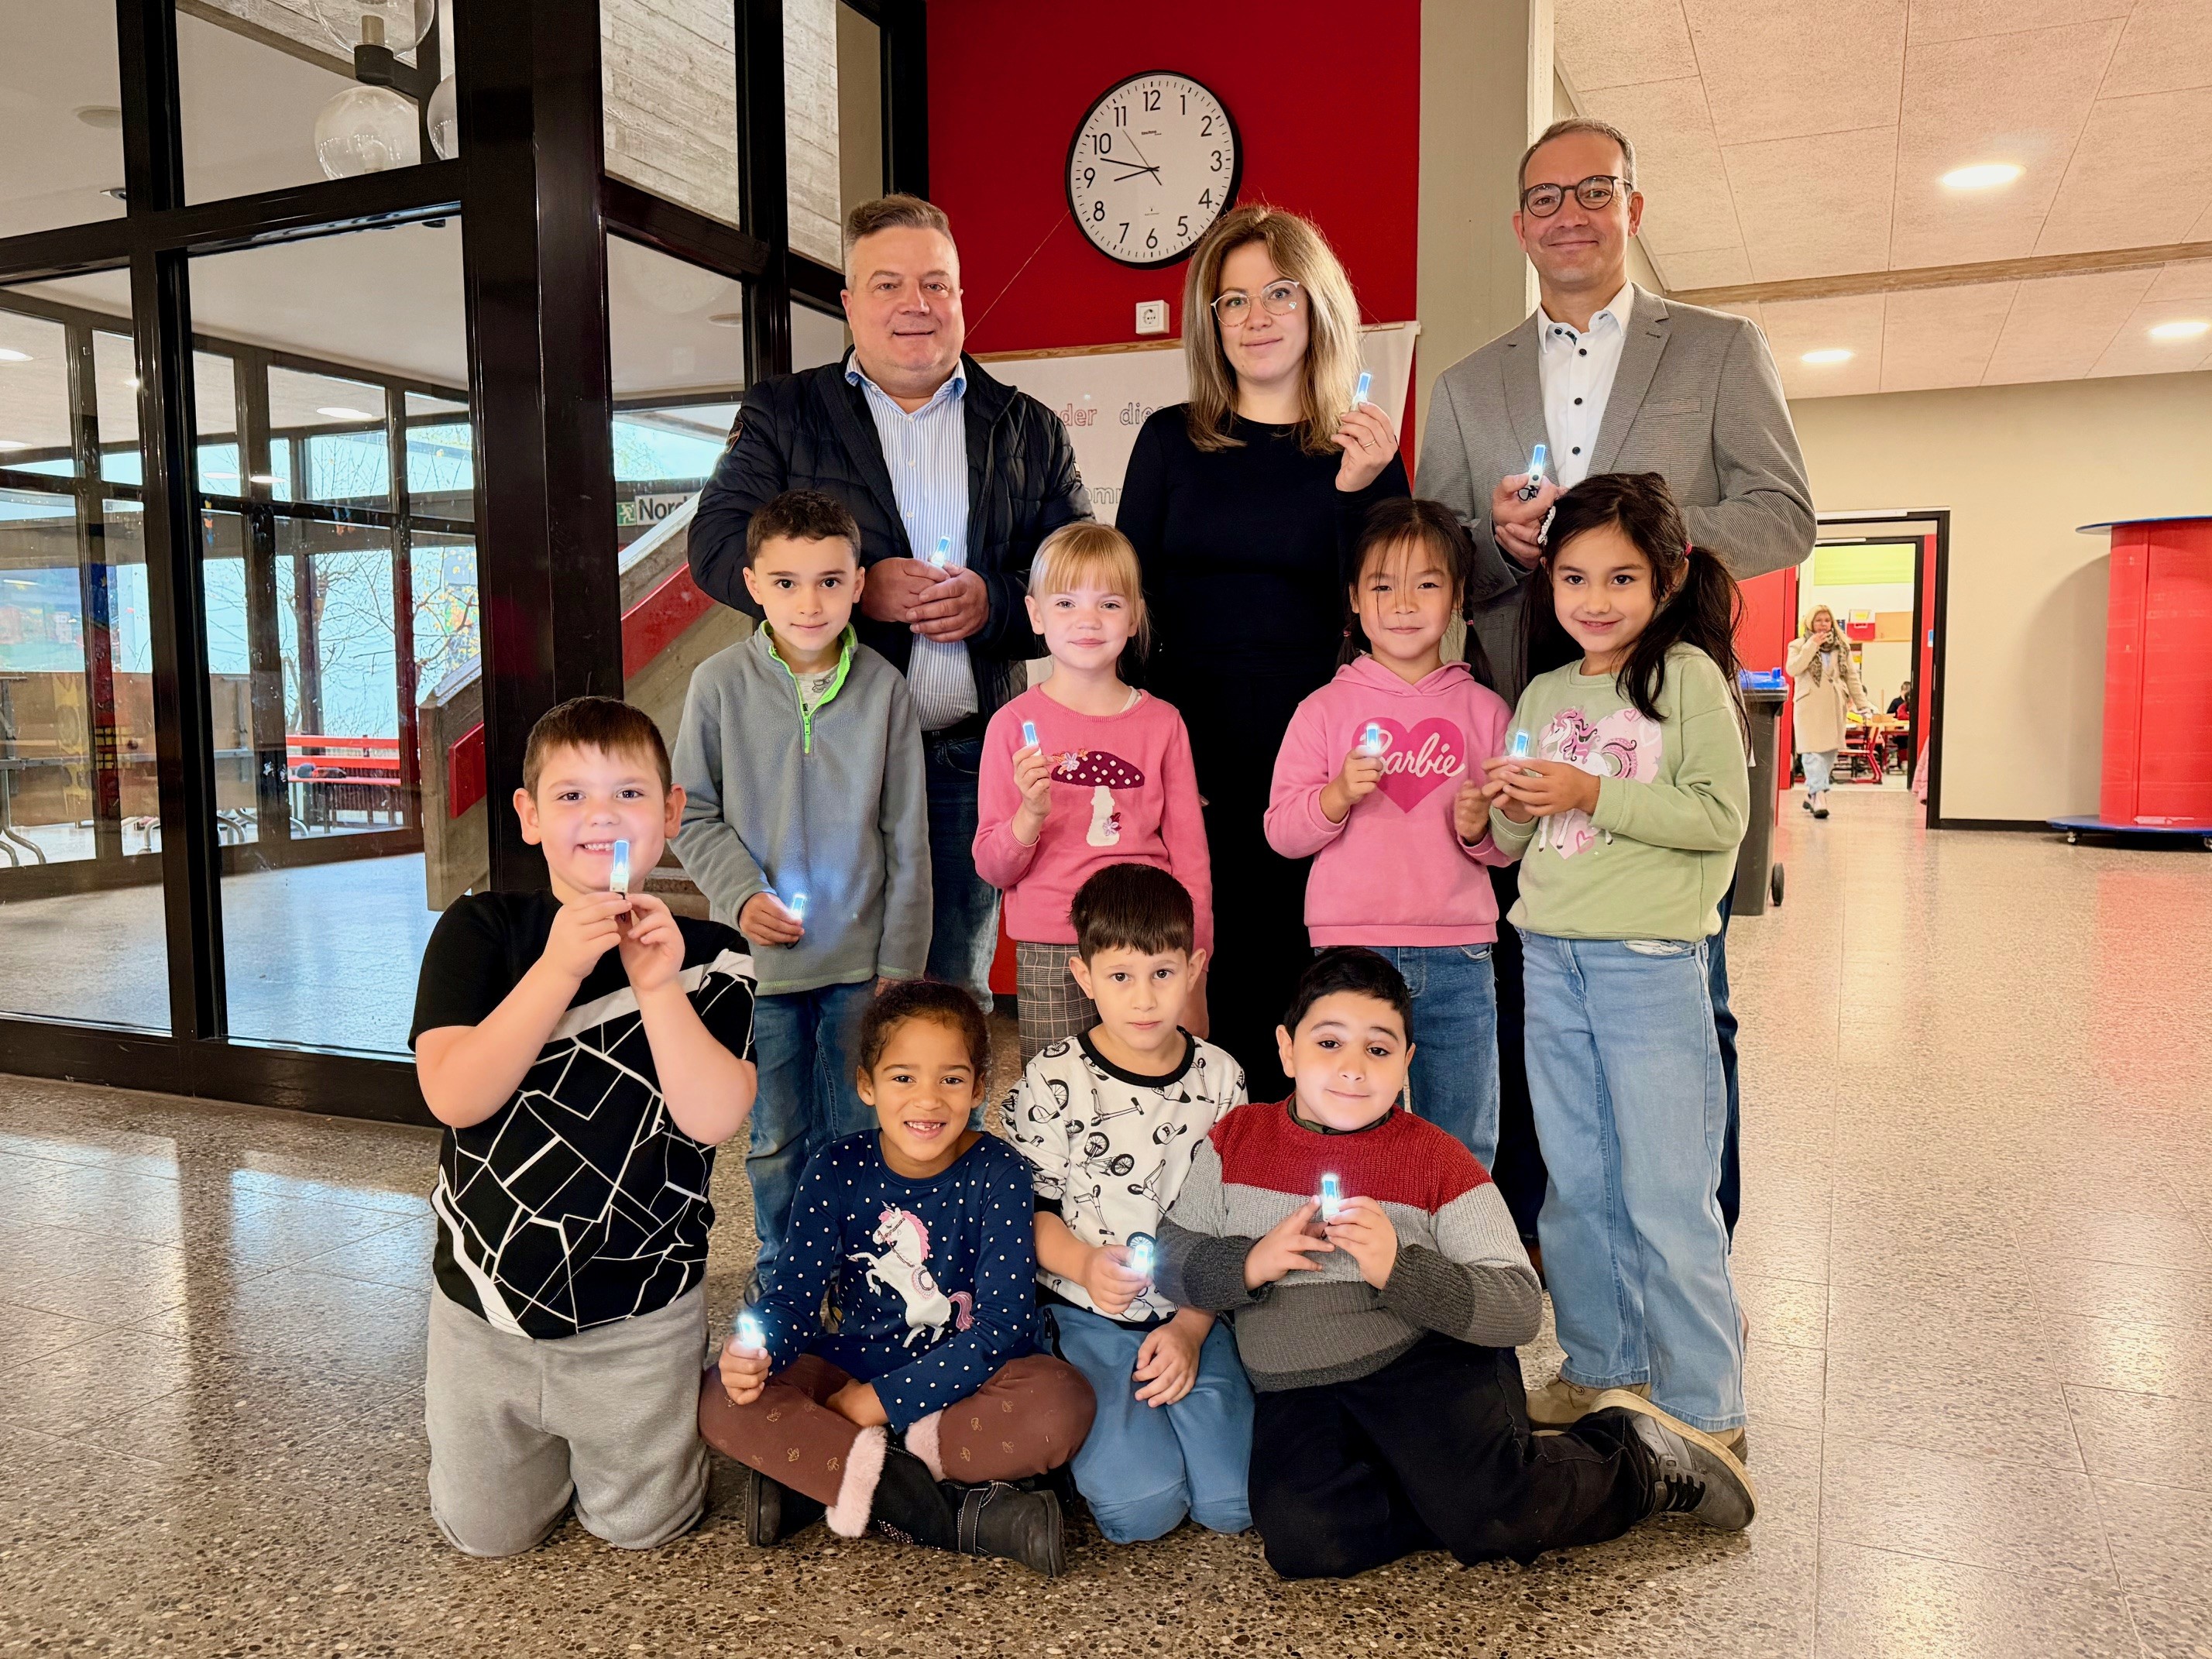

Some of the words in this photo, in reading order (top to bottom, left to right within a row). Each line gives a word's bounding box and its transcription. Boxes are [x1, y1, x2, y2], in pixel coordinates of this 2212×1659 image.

[1142, 89, 1161, 112] 12
[1180, 94, 1186, 115] 1
[1114, 105, 1127, 127] 11
[1200, 115, 1212, 137] 2
[1091, 132, 1111, 155] 10
[1210, 149, 1222, 172] 3
[1084, 167, 1096, 188] 9
[1197, 188, 1213, 209] 4
[1093, 200, 1105, 222] 8
[1118, 222, 1130, 244] 7
[1176, 215, 1188, 237] 5
[1146, 228, 1158, 249] 6
[1056, 403, 1097, 427] der
[1119, 402, 1165, 426] die
[1162, 1125, 1170, 1137] B
